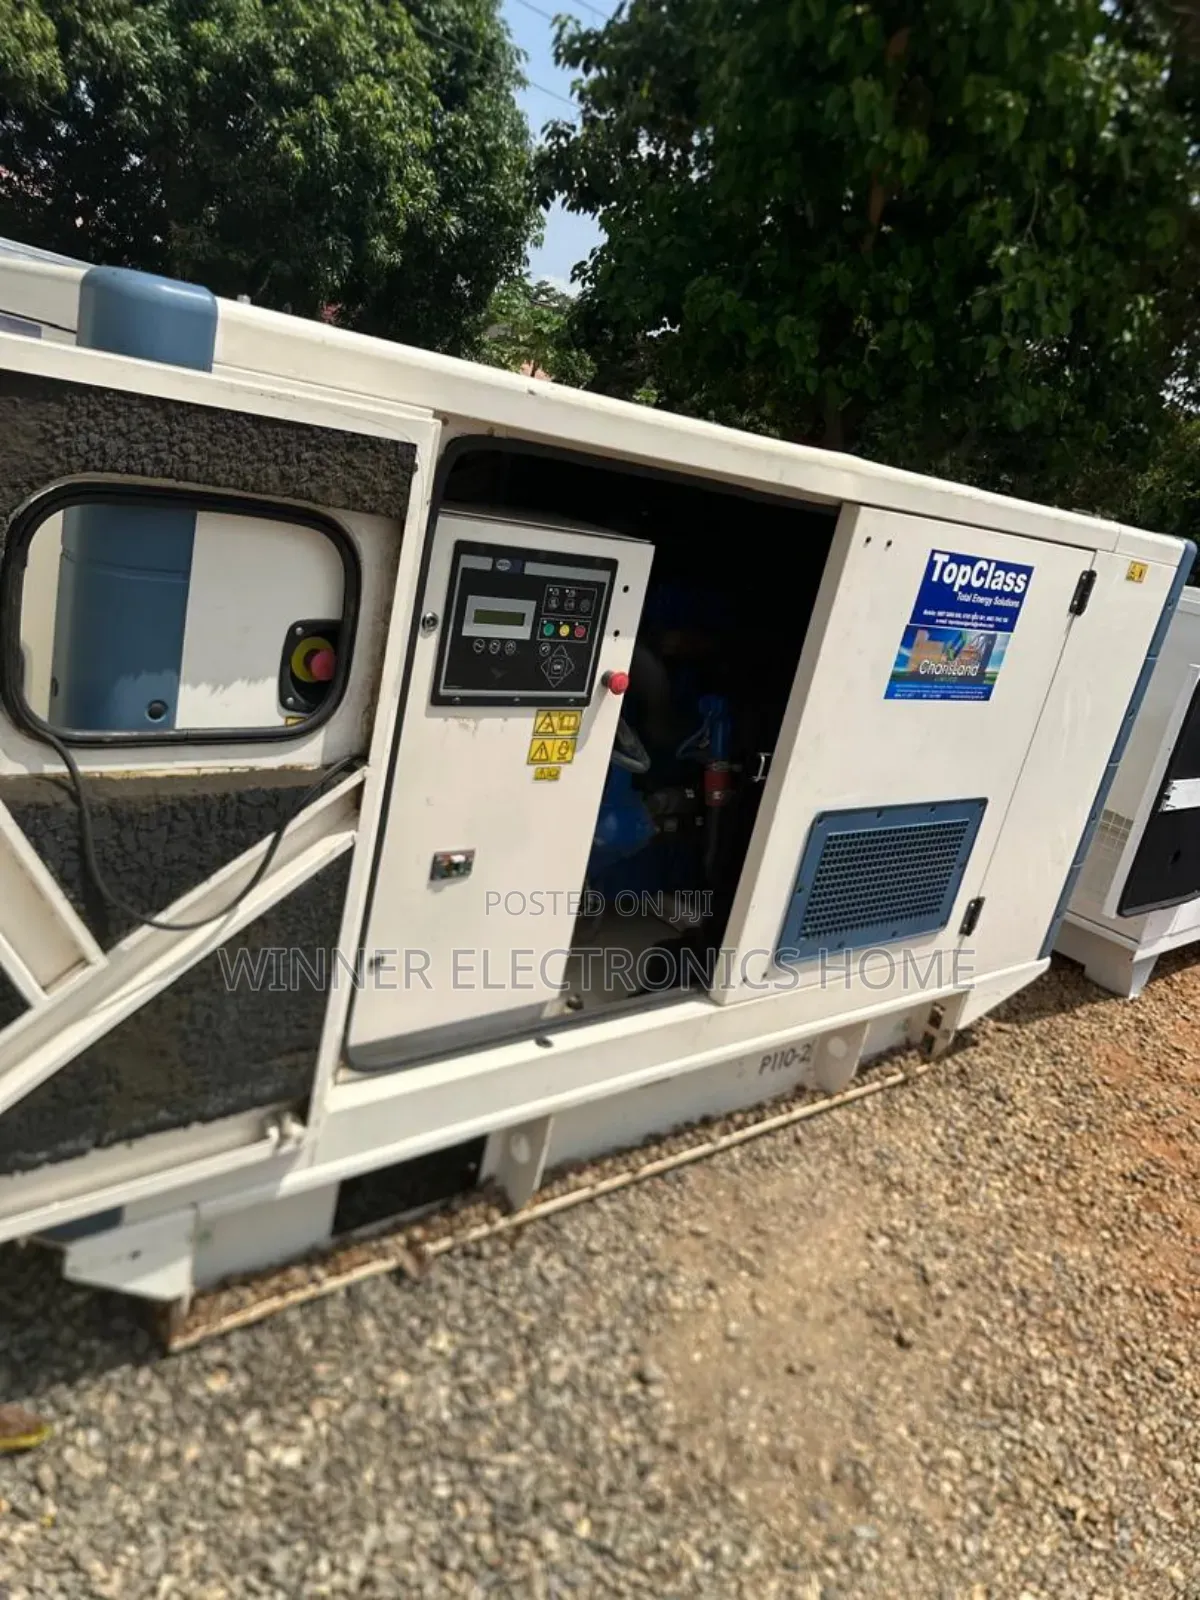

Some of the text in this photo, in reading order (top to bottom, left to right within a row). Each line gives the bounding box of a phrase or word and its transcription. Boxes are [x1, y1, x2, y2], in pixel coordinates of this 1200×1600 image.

[931, 552, 1028, 594] TopClass
[957, 591, 1020, 608] Total Energy Solutions
